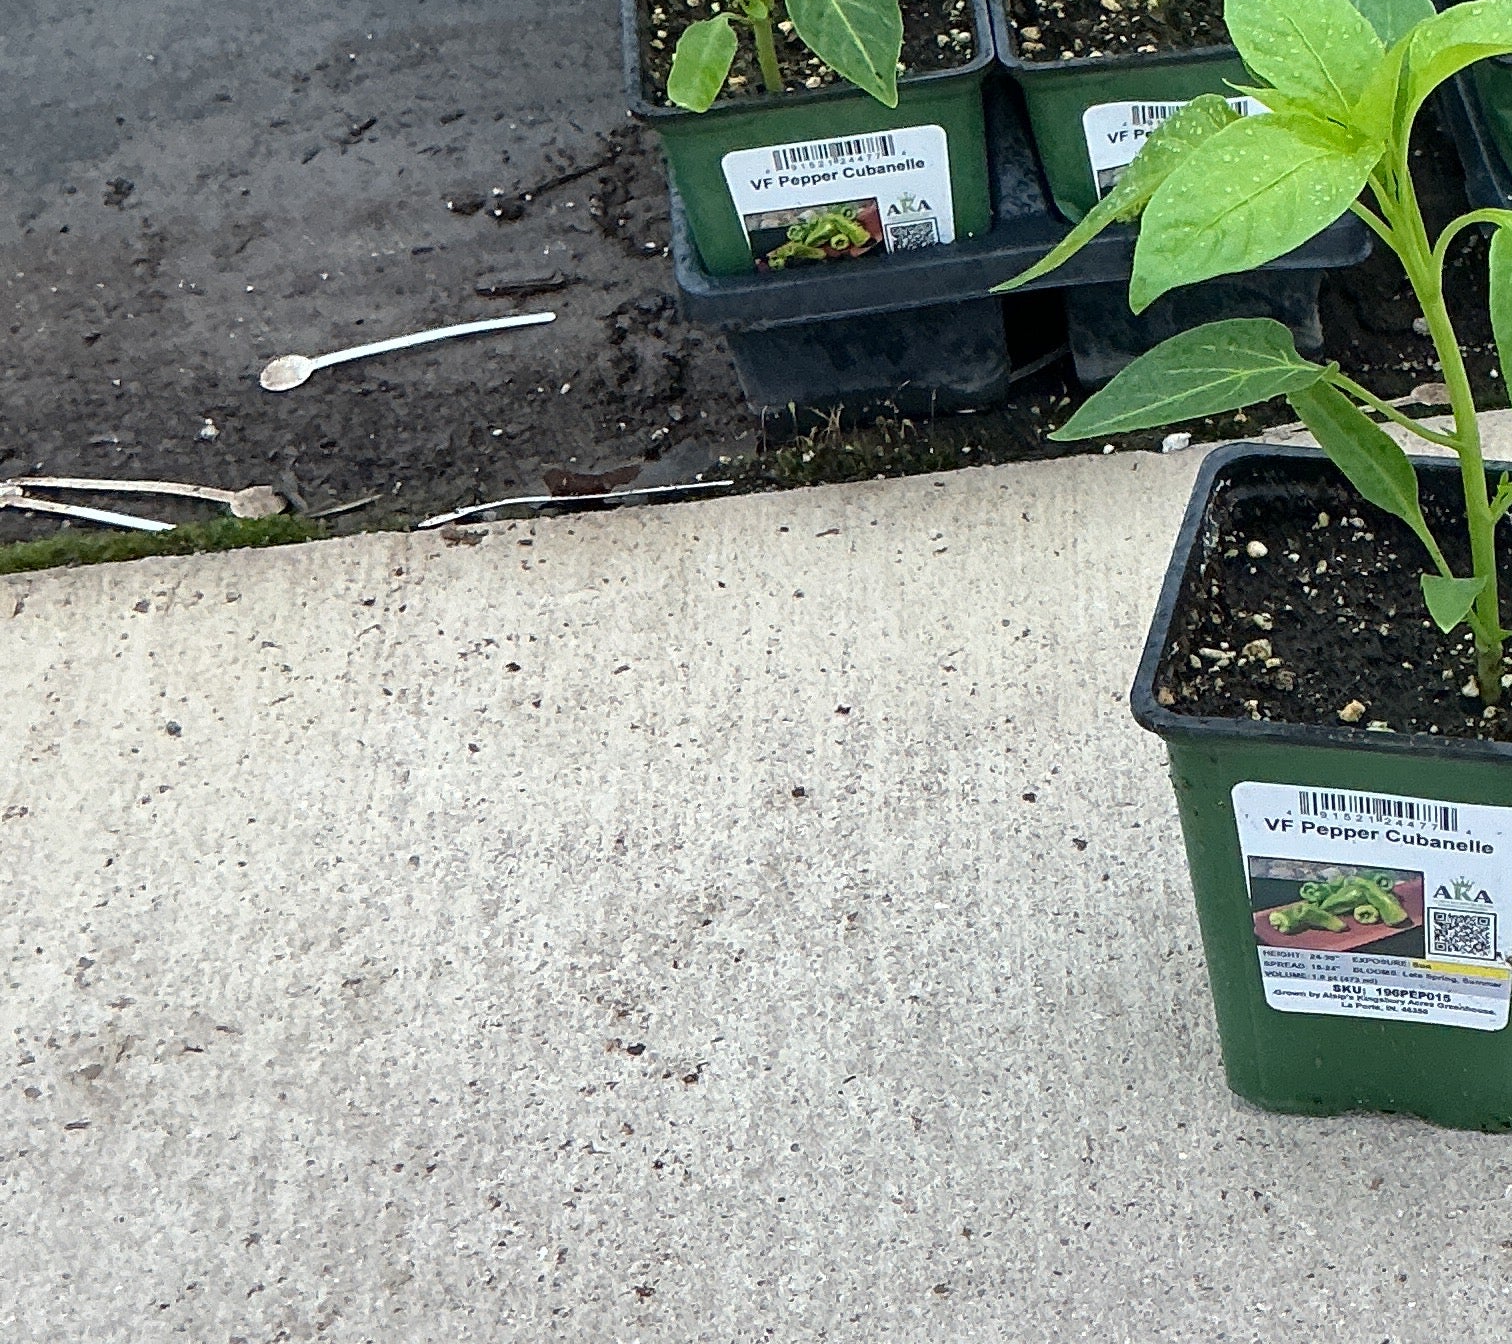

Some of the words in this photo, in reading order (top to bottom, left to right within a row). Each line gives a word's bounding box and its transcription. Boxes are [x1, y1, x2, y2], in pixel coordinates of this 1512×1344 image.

[1107, 130, 1129, 144] VF
[750, 177, 774, 191] VF
[778, 171, 838, 187] Pepper
[843, 158, 925, 178] Cubanelle
[1264, 817, 1294, 832] VF
[1301, 821, 1379, 840] Pepper
[1385, 829, 1494, 854] Cubanelle
[1433, 876, 1493, 904] AKA
[1332, 984, 1367, 996] SKU:
[1375, 987, 1451, 1002] 196PEP015
